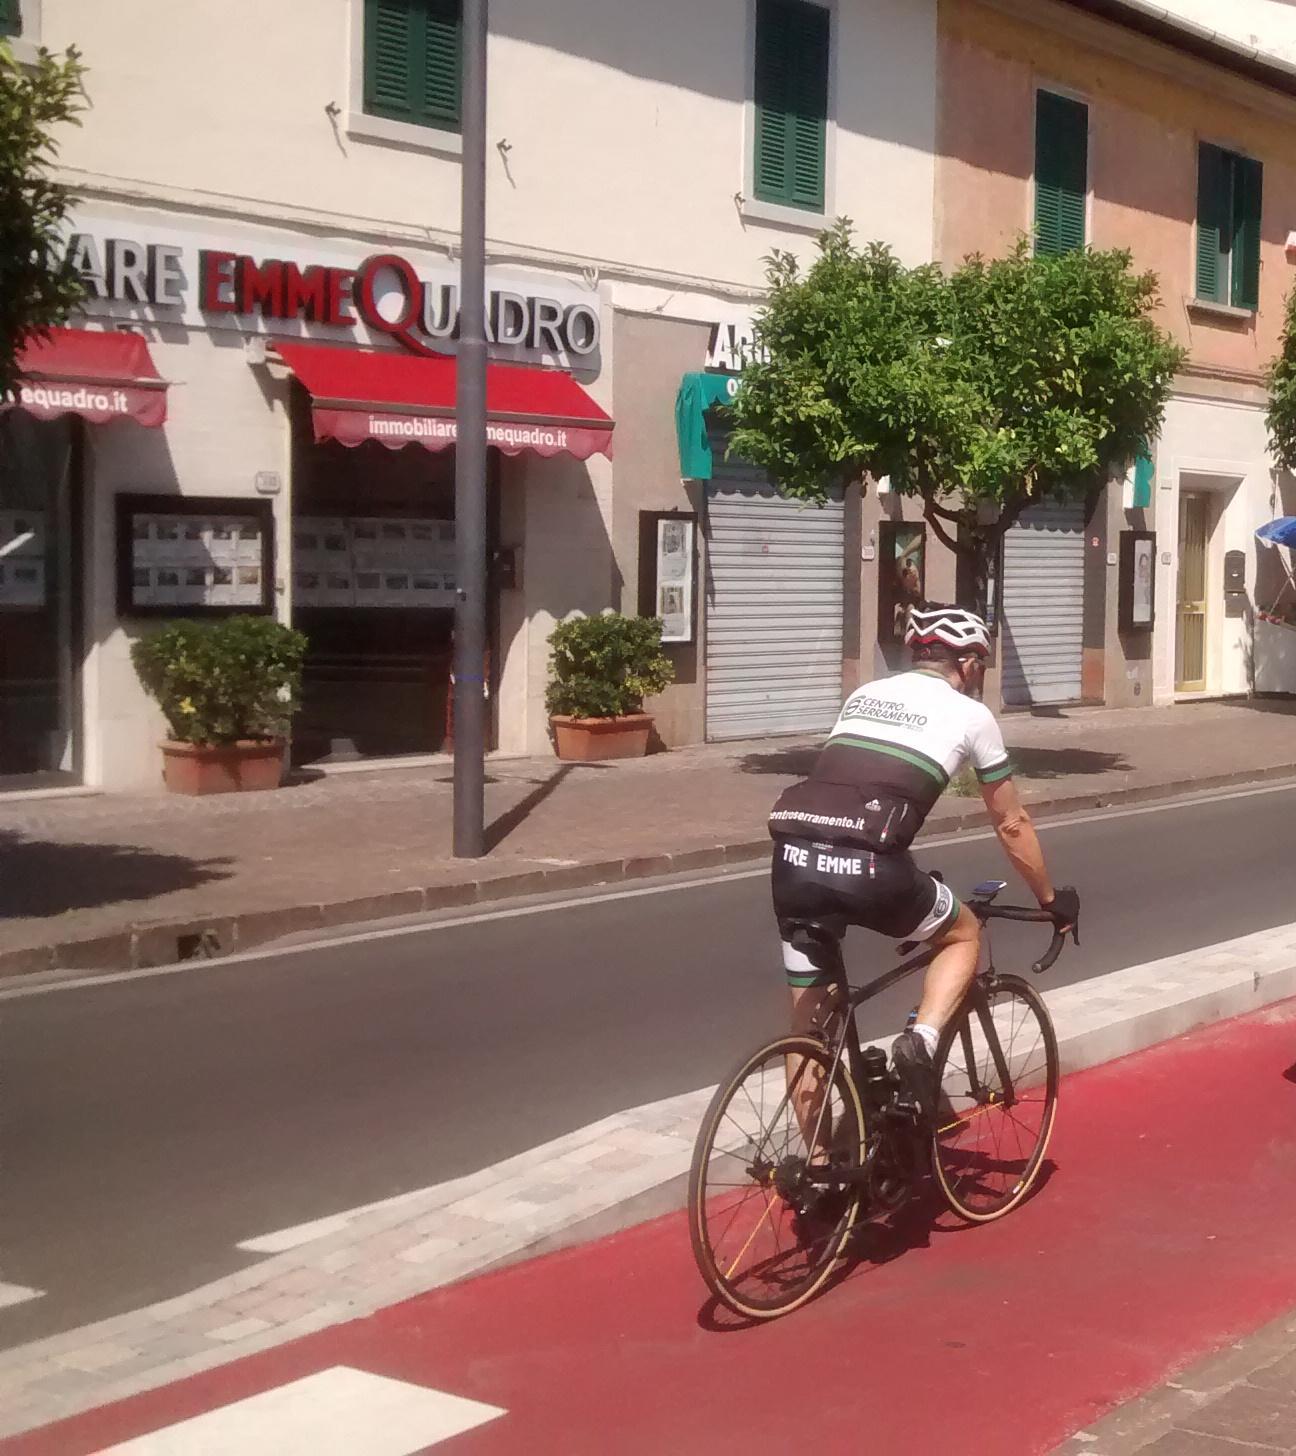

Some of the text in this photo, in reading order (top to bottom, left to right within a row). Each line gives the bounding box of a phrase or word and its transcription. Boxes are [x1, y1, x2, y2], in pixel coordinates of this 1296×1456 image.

[68, 233, 184, 306] ARE
[863, 698, 904, 711] CENTRO
[856, 706, 928, 726] SERRAMENTO
[769, 810, 865, 830] entroserramento.it
[783, 843, 862, 875] TRE EMME
